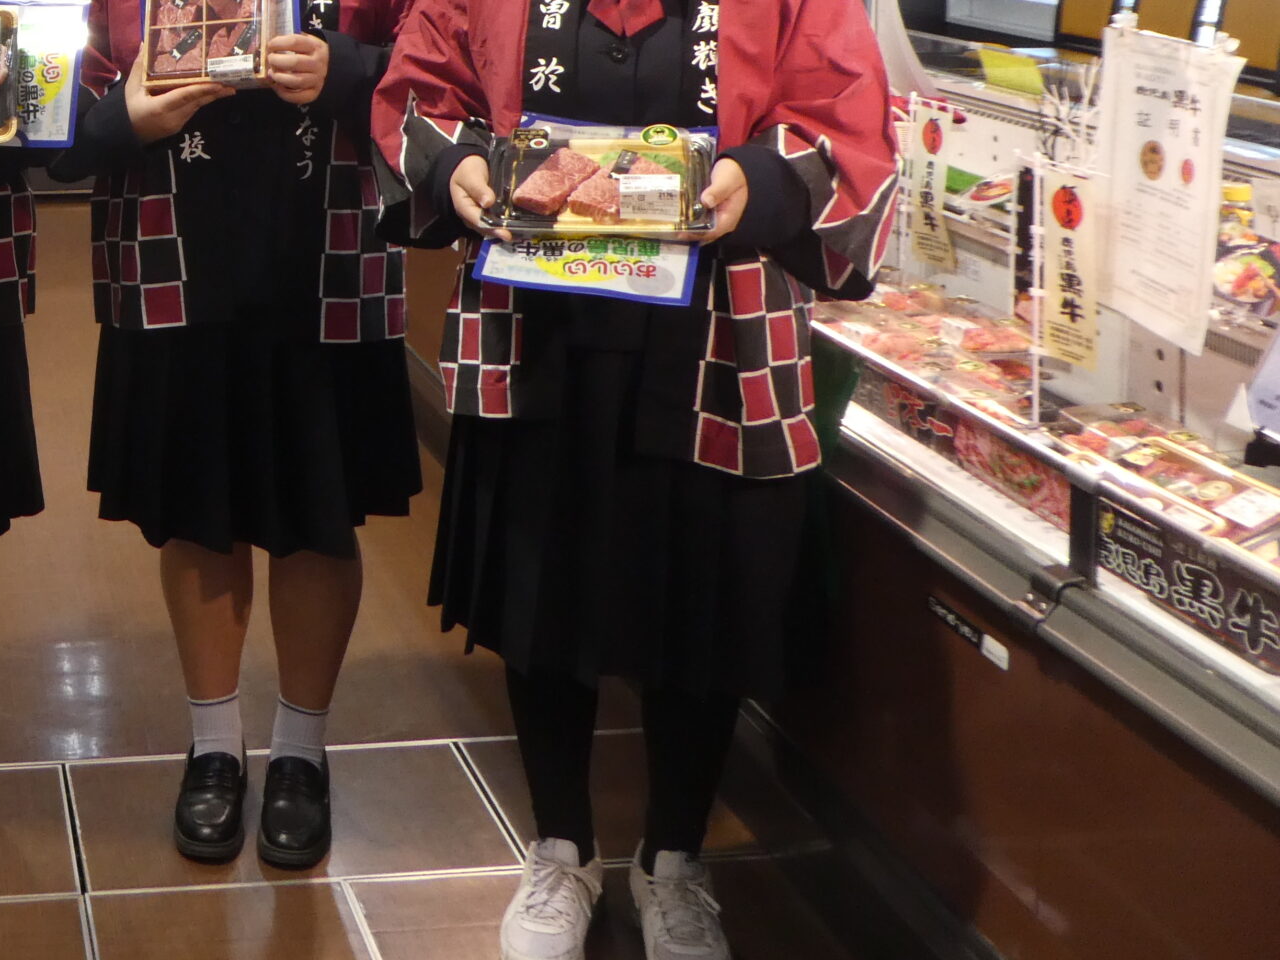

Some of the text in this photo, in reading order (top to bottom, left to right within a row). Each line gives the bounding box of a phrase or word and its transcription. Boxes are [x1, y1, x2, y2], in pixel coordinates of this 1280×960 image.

[179, 131, 212, 163] 校
[564, 260, 657, 279] おいしい
